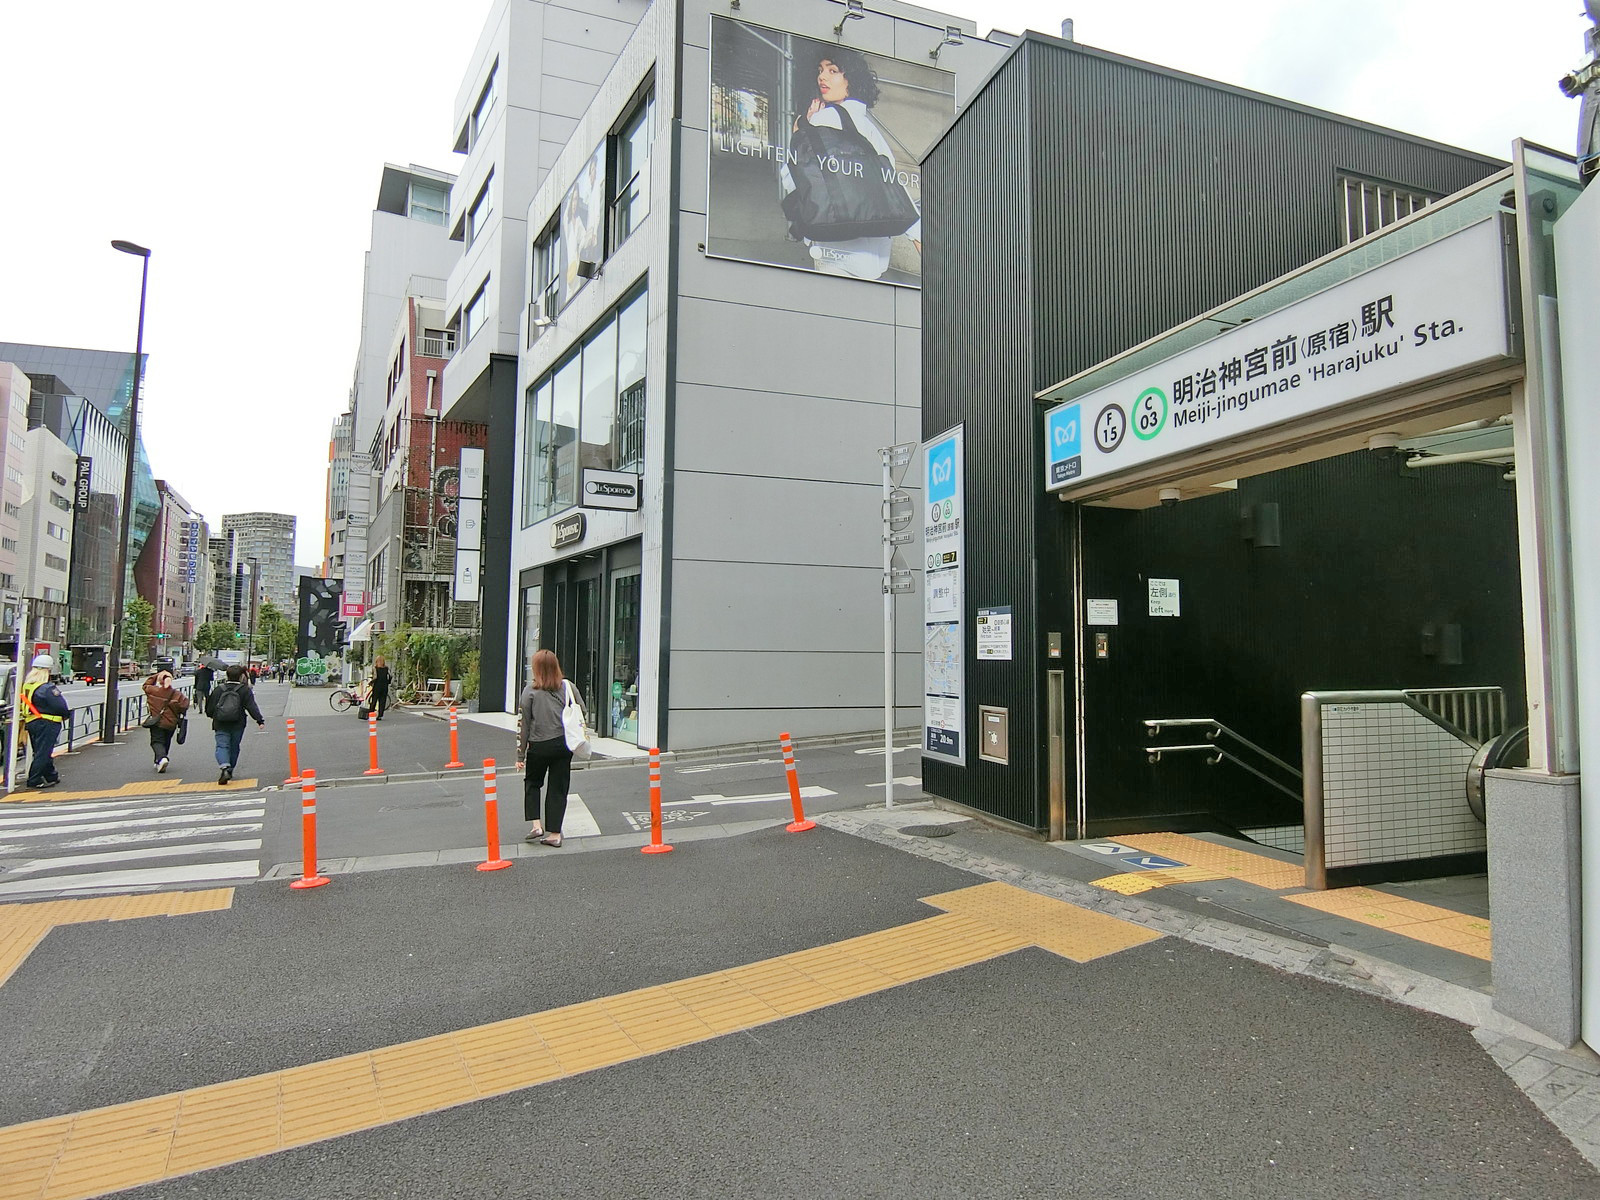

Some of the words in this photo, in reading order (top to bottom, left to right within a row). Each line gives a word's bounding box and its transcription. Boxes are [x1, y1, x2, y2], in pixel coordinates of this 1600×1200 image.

[720, 137, 798, 165] LIGHTEN
[816, 154, 864, 178] YOUR
[1174, 373, 1301, 428] Meiji-jingumae
[1414, 319, 1464, 347] Sta.
[1145, 396, 1153, 411] C
[1107, 411, 1113, 426] F
[1140, 411, 1158, 430] 03
[1103, 426, 1118, 443] 15
[80, 461, 90, 477] PAL
[77, 478, 89, 508] GROUP
